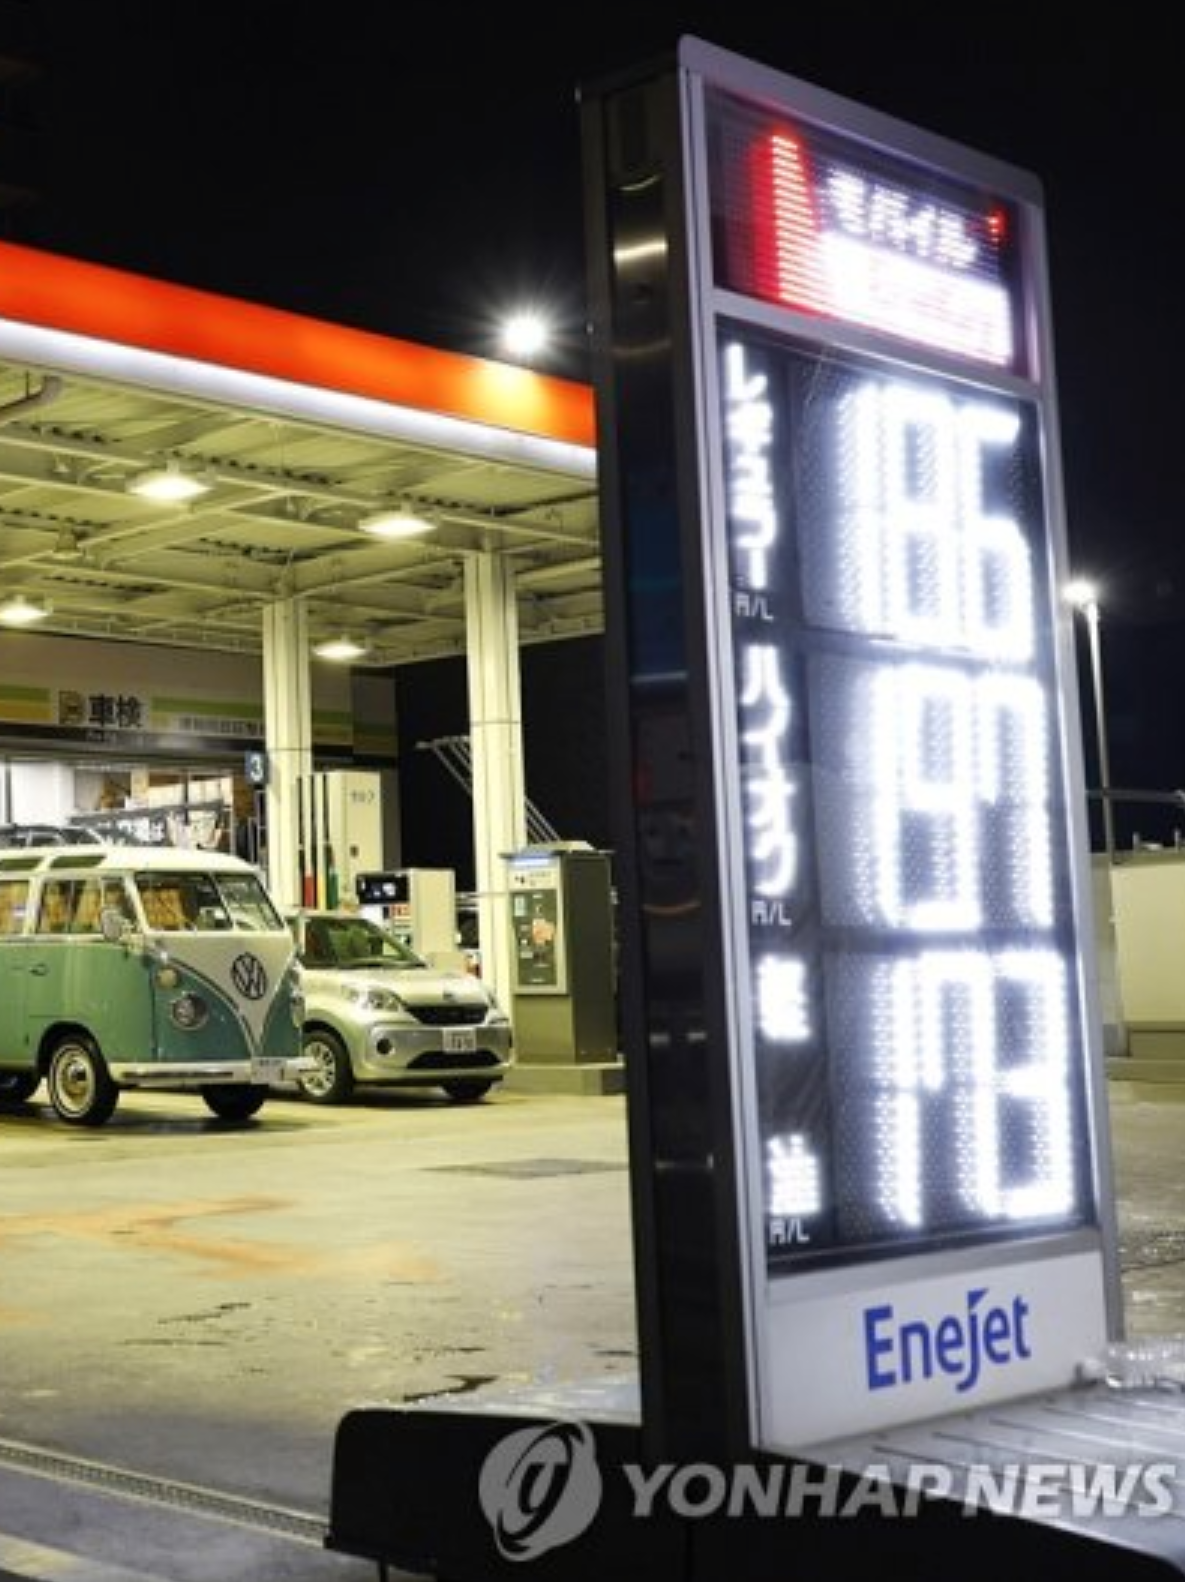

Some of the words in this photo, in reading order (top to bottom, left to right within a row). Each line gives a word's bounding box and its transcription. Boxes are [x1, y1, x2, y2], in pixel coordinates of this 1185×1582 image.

[250, 752, 263, 781] 3
[740, 644, 799, 898] ハイオク
[863, 1288, 1031, 1393] Enejet
